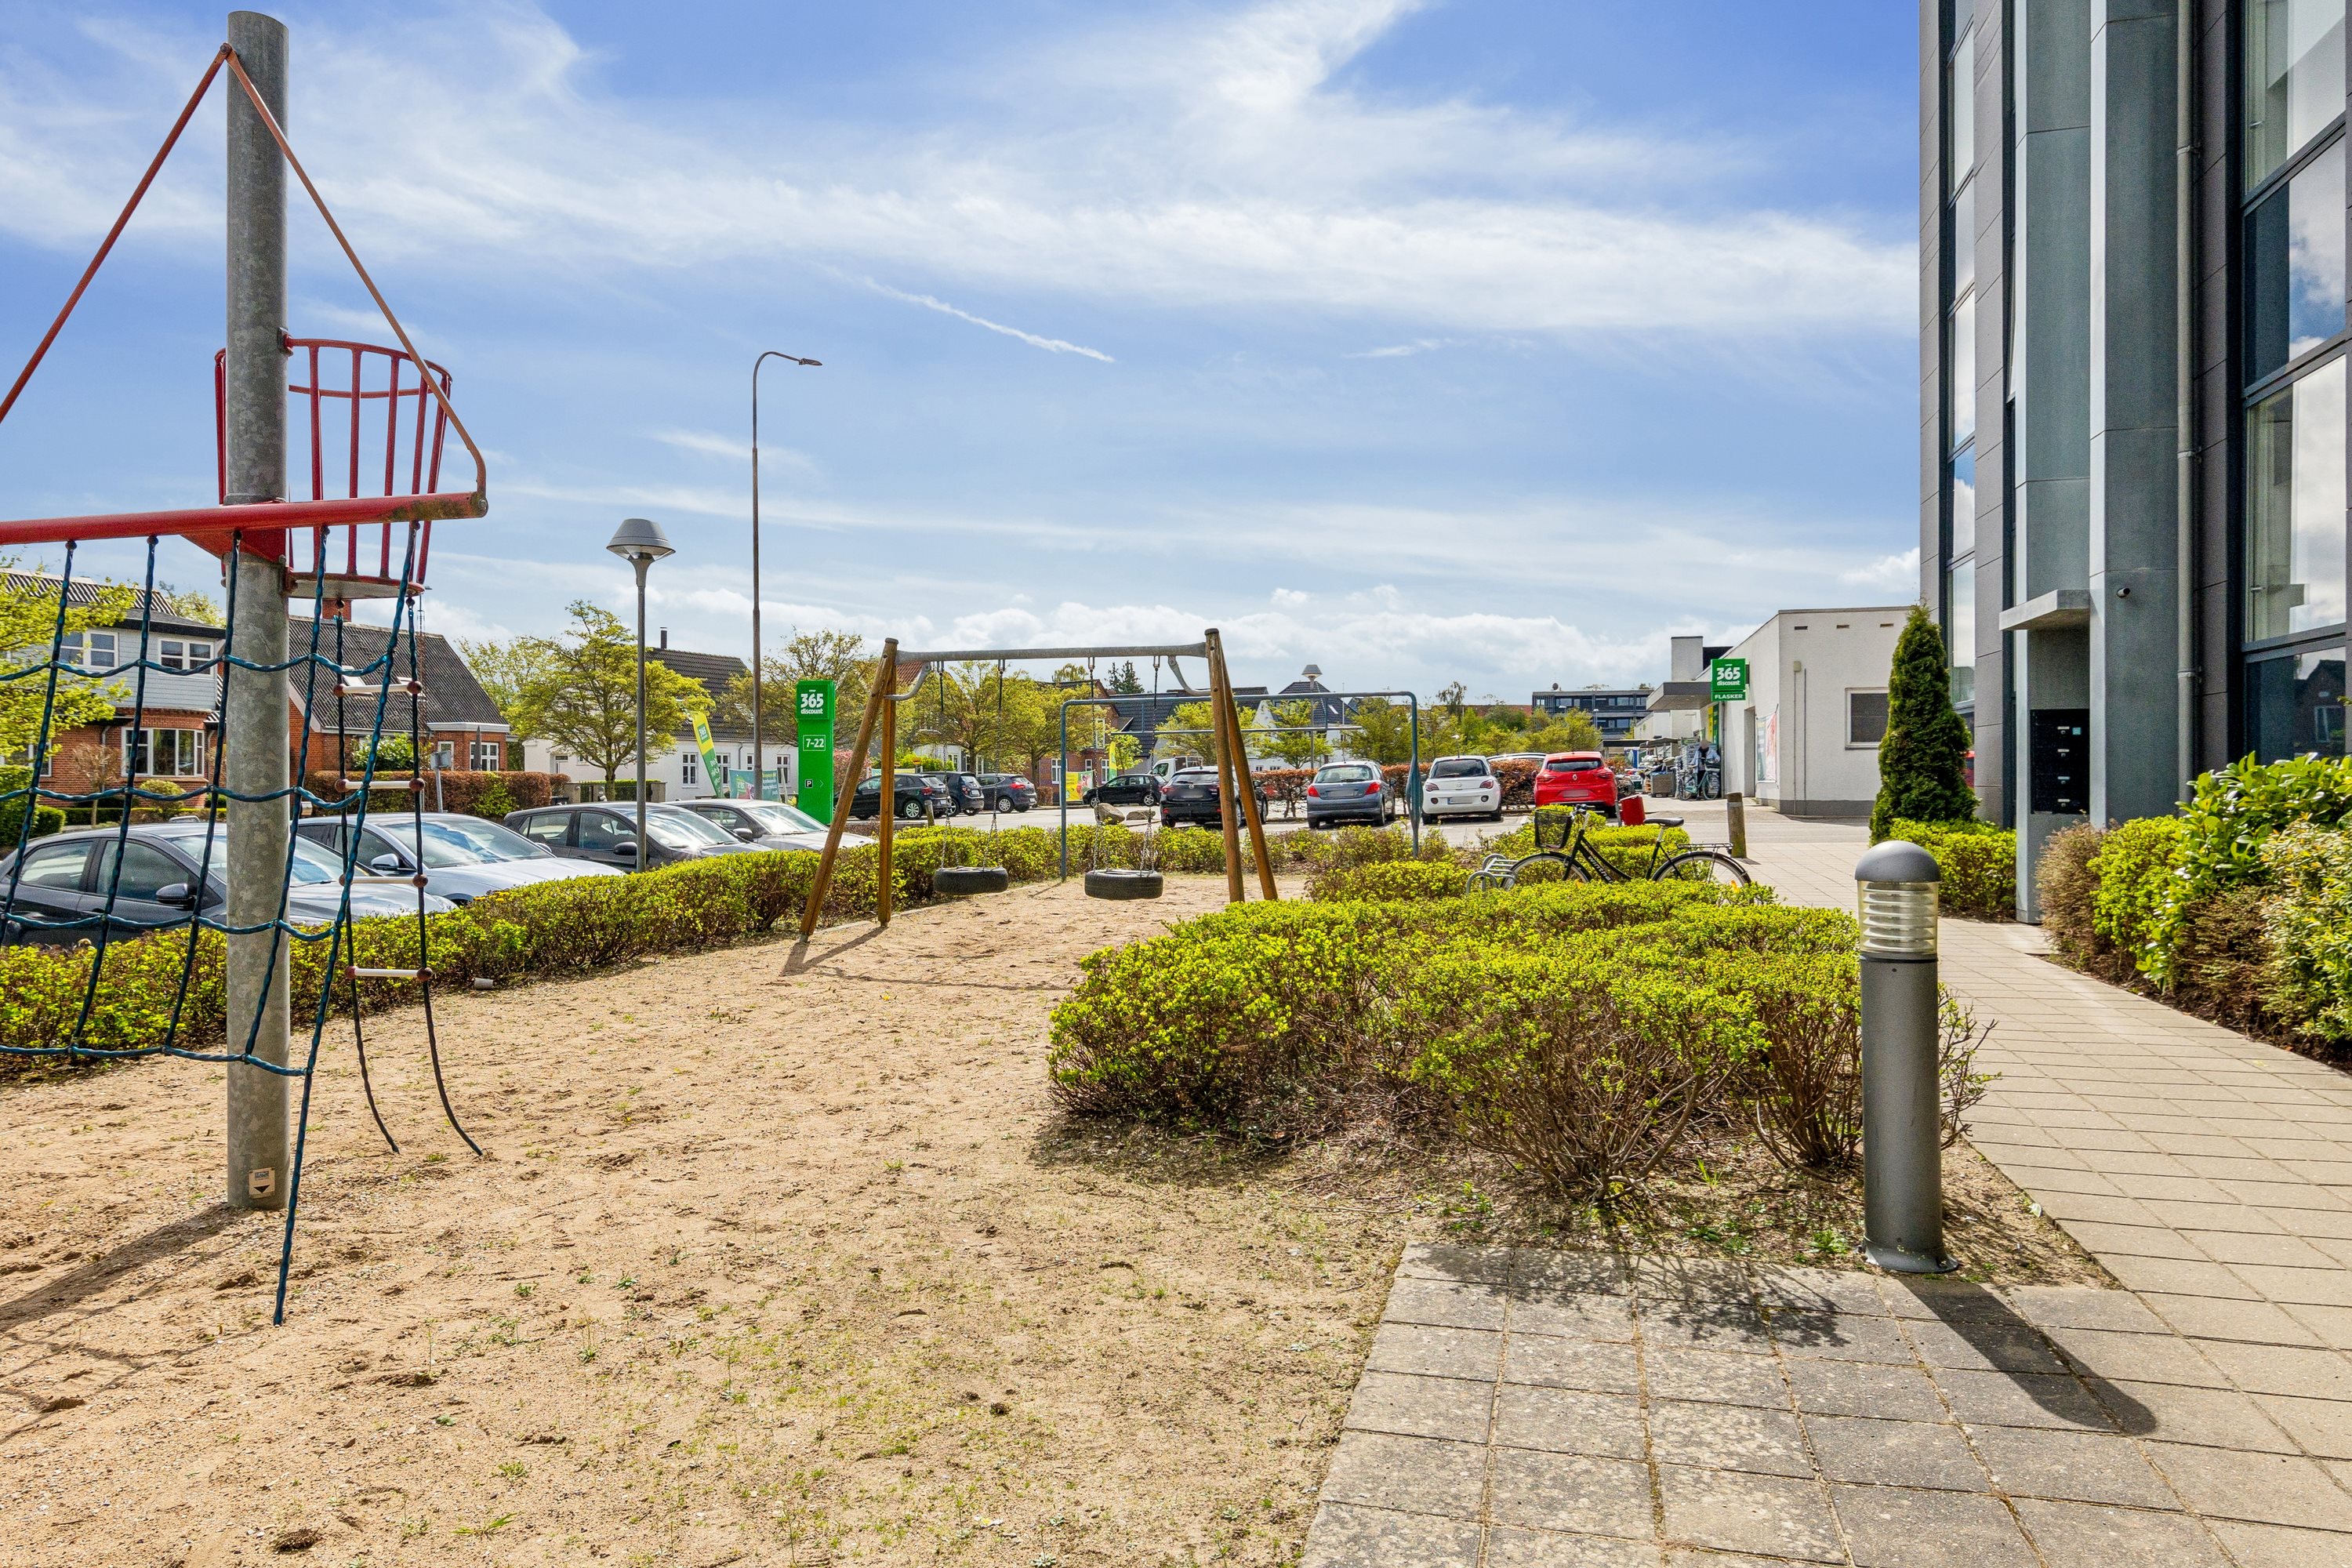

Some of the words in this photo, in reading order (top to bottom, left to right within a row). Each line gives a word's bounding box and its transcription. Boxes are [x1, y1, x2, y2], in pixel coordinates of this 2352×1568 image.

[1717, 667, 1740, 681] 365
[800, 693, 824, 708] 365
[806, 738, 825, 748] 7-22
